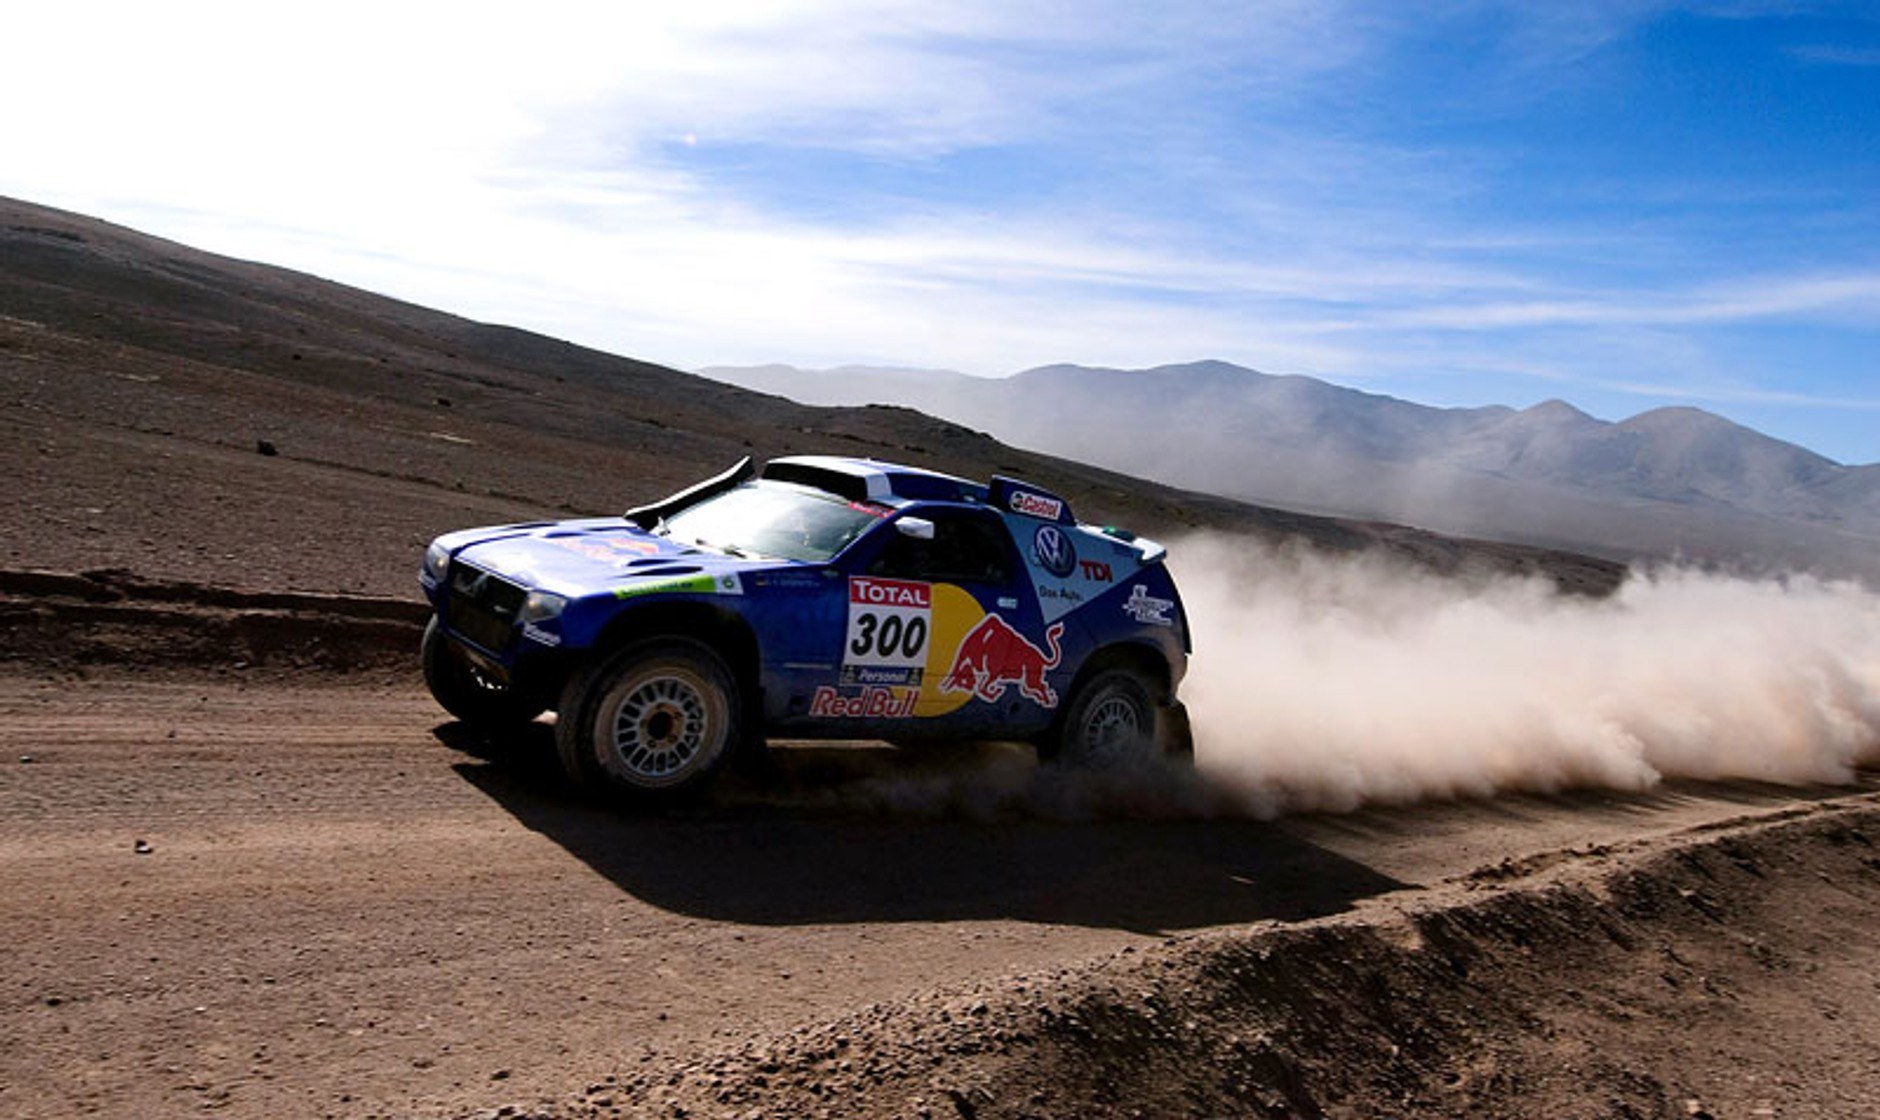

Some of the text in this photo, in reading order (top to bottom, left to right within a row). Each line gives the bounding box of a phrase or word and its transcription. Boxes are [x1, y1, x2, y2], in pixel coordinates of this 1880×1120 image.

[1079, 560, 1112, 583] TDI
[852, 580, 929, 605] TOTAL
[851, 613, 926, 658] 300
[857, 668, 909, 682] Personal
